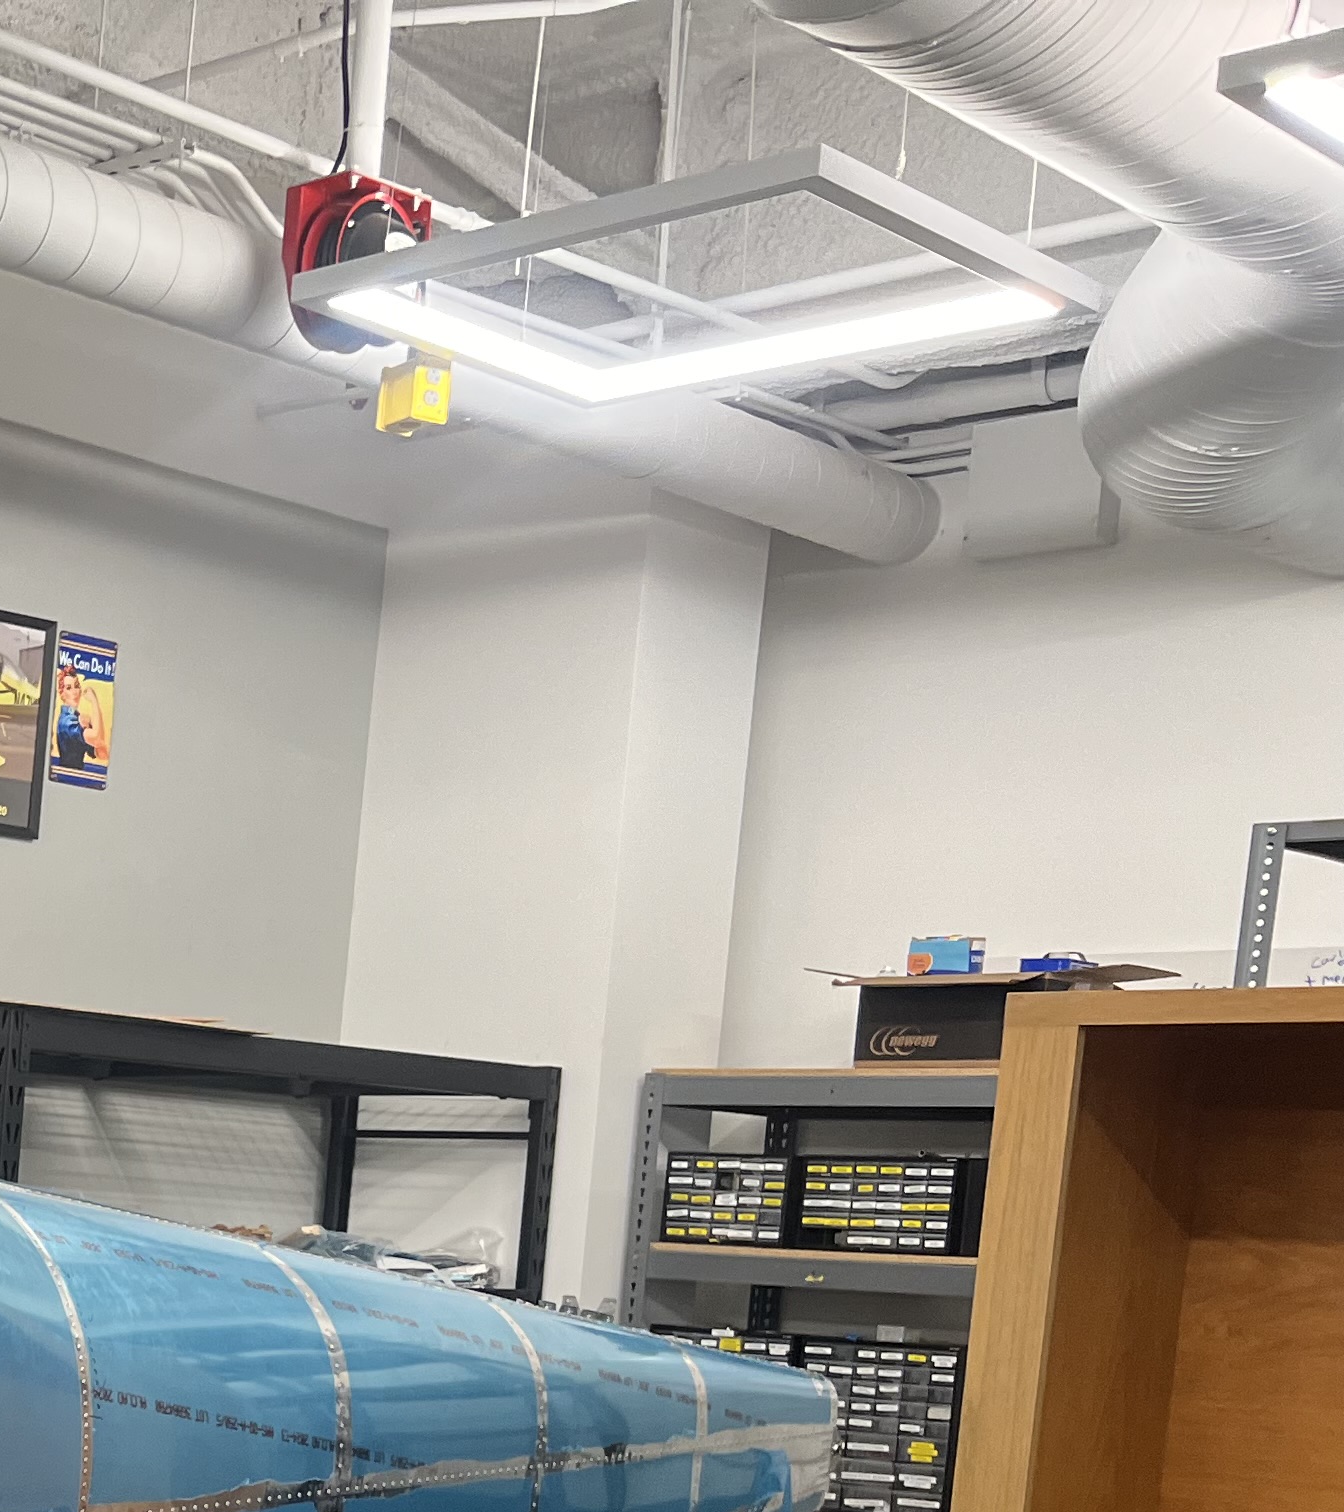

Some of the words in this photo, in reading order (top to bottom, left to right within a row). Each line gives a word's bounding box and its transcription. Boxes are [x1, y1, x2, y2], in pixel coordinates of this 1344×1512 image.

[59, 650, 72, 666] We
[74, 654, 90, 671] Can
[91, 657, 103, 674] Do
[104, 661, 116, 676] It!
[889, 1034, 939, 1047] newegg
